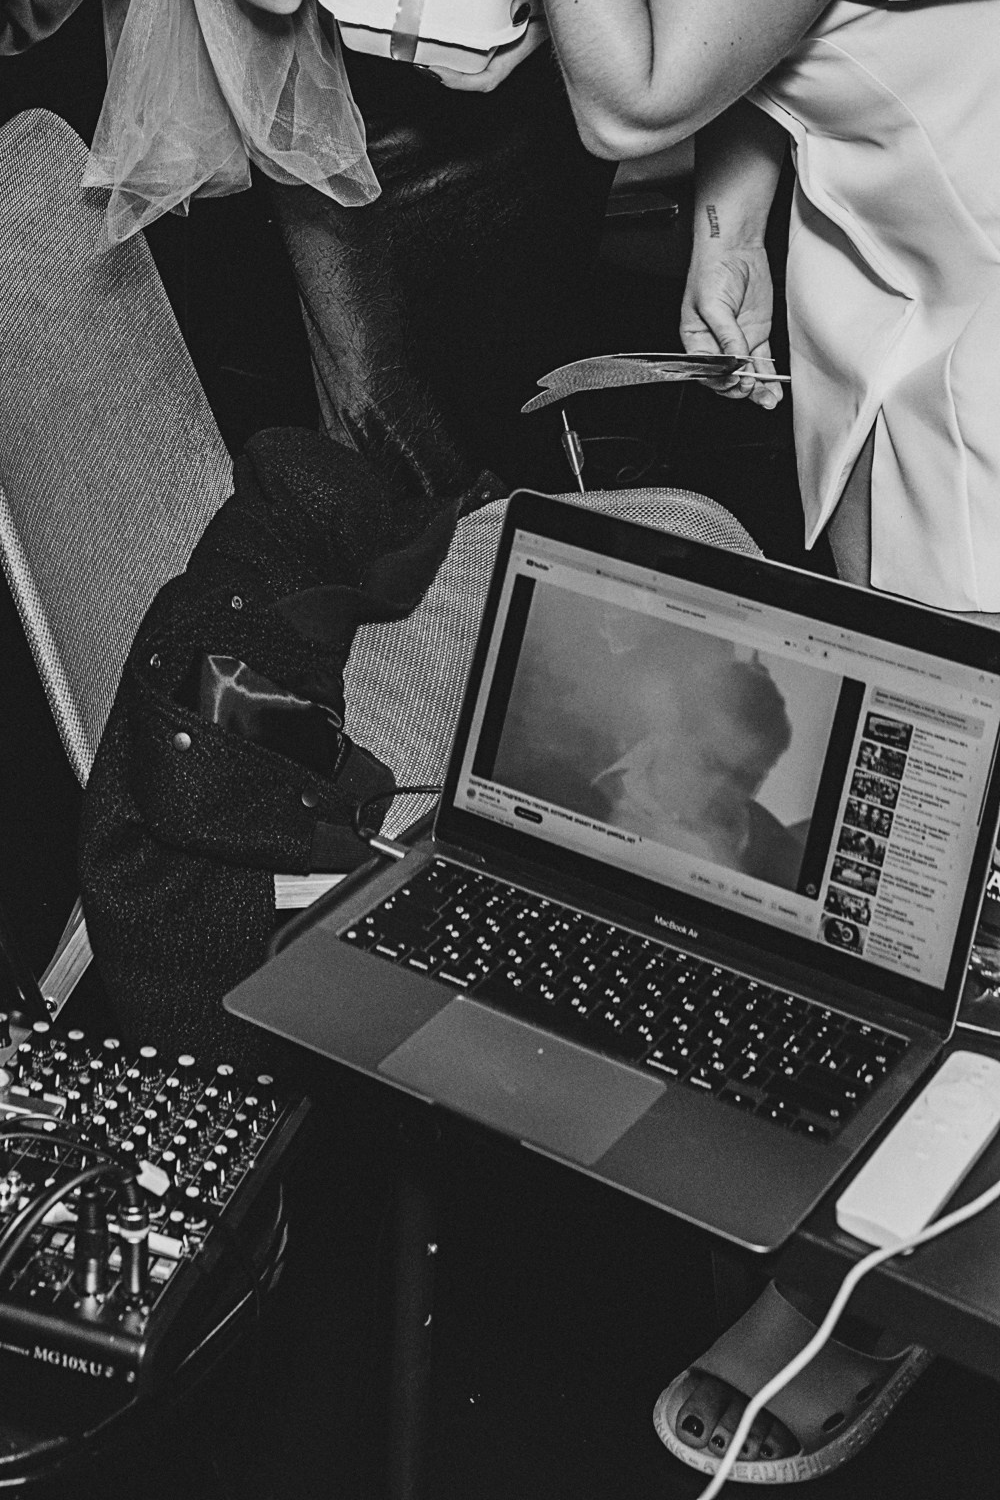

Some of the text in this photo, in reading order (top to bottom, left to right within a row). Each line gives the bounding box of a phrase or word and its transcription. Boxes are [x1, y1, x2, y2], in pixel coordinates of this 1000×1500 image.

[654, 914, 698, 938] MacBook Air
[33, 1346, 102, 1377] MG10XU
